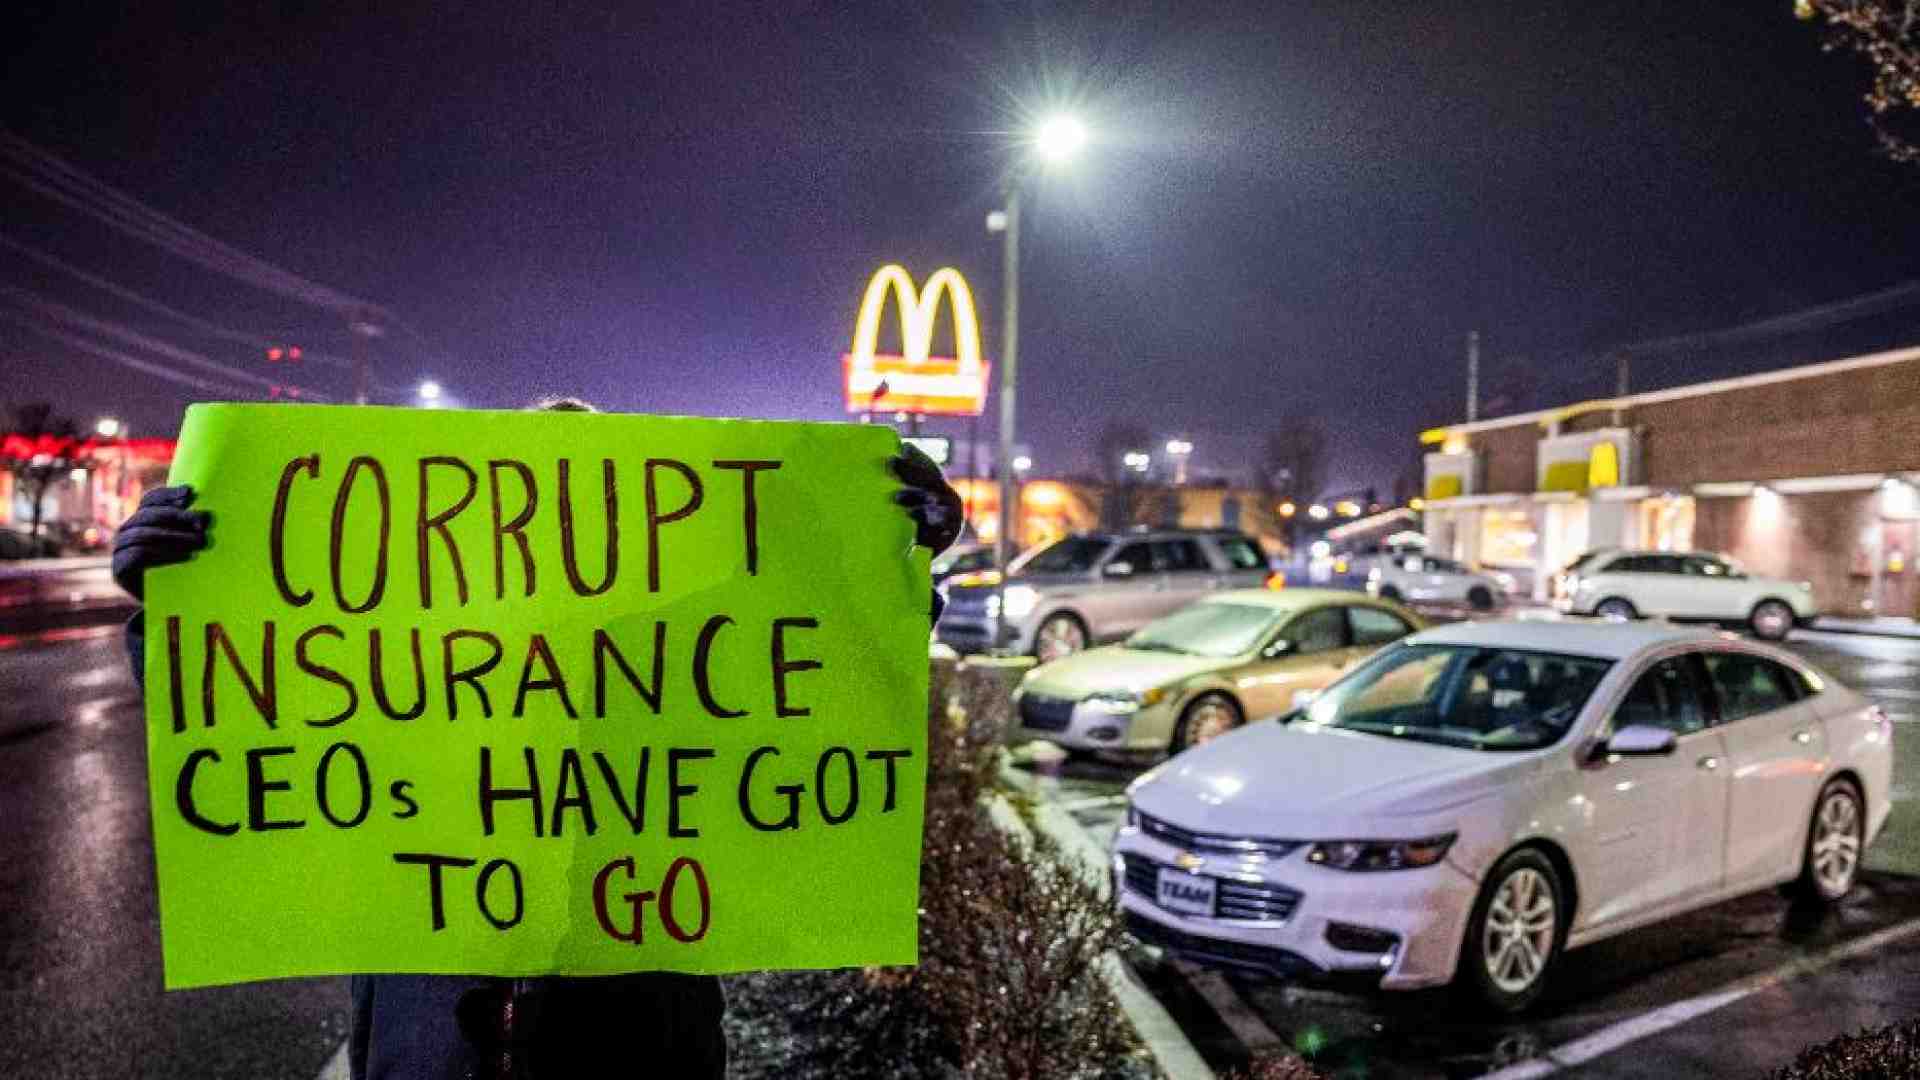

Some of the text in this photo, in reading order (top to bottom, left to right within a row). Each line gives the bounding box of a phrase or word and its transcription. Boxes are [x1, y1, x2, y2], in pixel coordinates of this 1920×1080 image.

[270, 454, 782, 613] CORRUPT
[166, 615, 823, 734] INSURANCE
[175, 742, 912, 838] CEOs HAVE GOT
[393, 853, 711, 946] TO GO
[1163, 881, 1210, 904] TEAM
